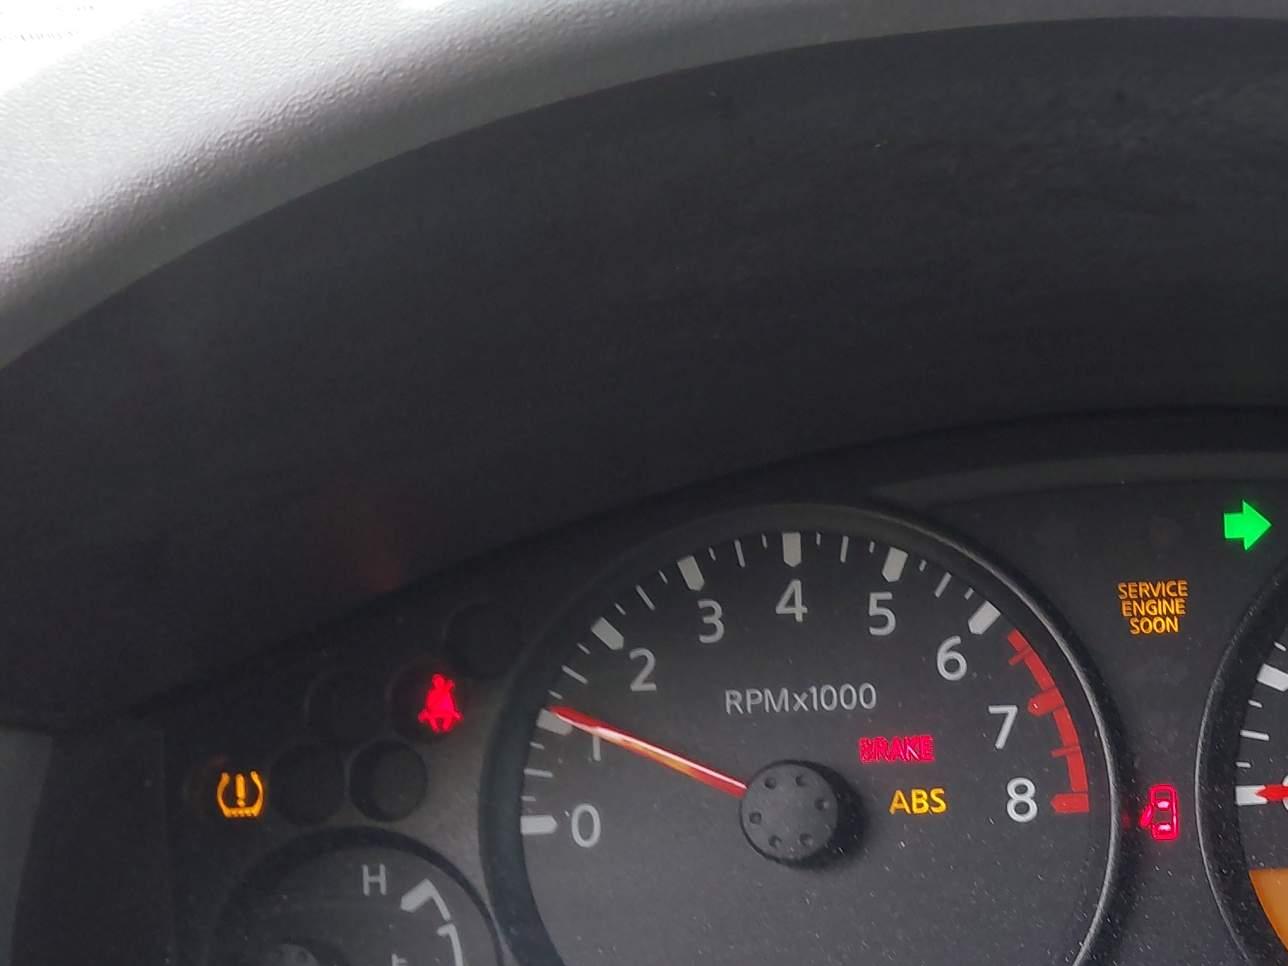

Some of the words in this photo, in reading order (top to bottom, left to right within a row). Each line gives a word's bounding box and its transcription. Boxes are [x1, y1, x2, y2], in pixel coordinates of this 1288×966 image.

[775, 580, 808, 622] 4
[1118, 580, 1188, 599] SERVICE
[1122, 598, 1186, 617] ENGINE
[698, 599, 724, 643] 3
[867, 592, 896, 635] 5
[1129, 616, 1179, 634] SOON
[629, 648, 658, 690] 2
[936, 635, 968, 679] 6
[725, 683, 877, 714] RPMx1000
[988, 705, 1018, 747] 7
[859, 736, 934, 762] BRAKE
[889, 788, 947, 815] ABS
[1005, 778, 1038, 823] 8
[570, 804, 601, 848] 0
[362, 865, 386, 896] H
